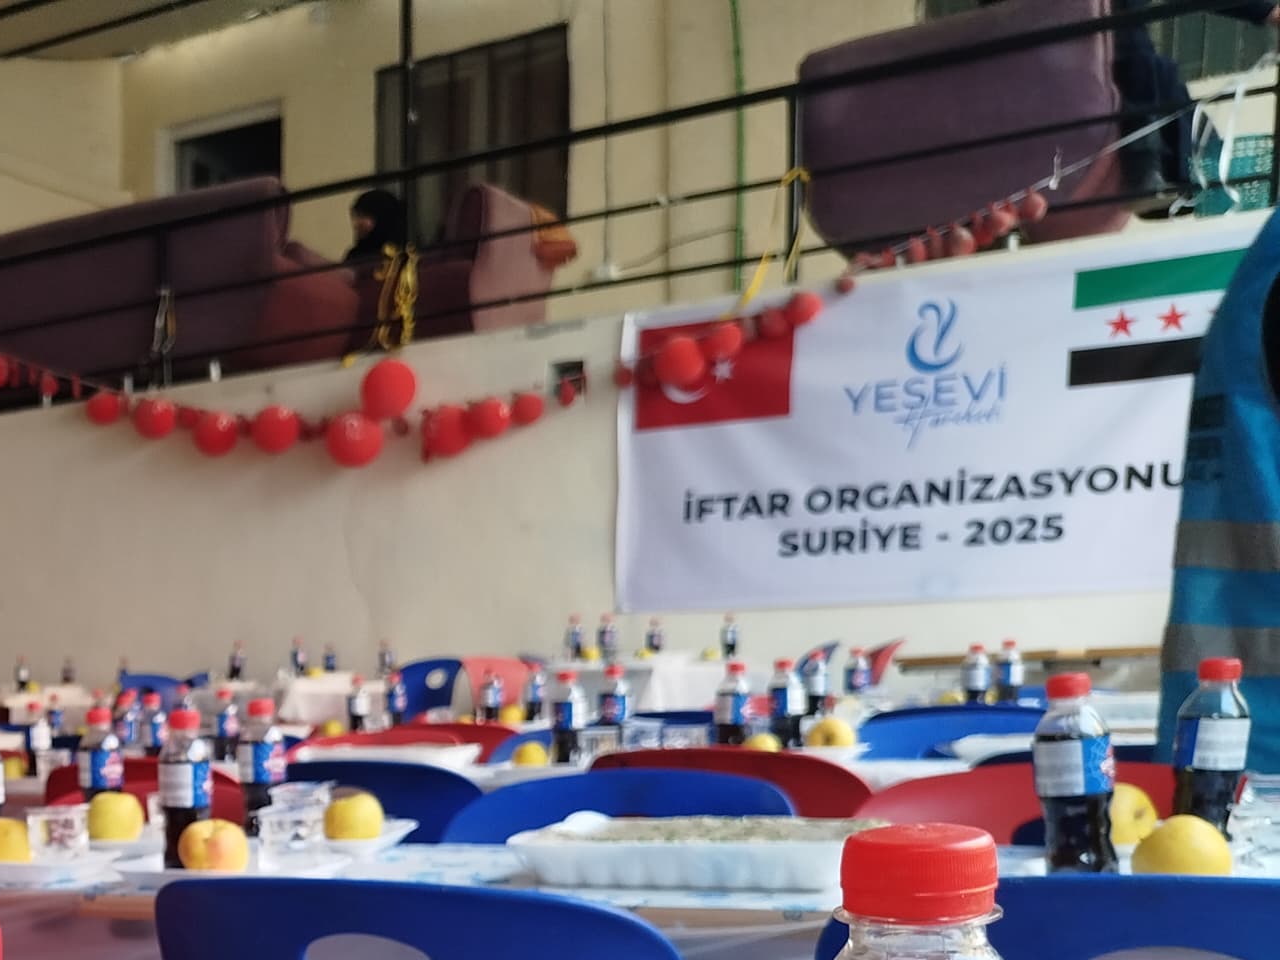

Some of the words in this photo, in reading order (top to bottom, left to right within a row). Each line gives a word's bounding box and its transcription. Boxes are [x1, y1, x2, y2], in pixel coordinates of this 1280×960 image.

[683, 489, 791, 524] İFTAR
[804, 461, 1185, 515] ORGANİZASYONU
[777, 517, 923, 558] SURİYE
[964, 514, 1065, 547] 2025
